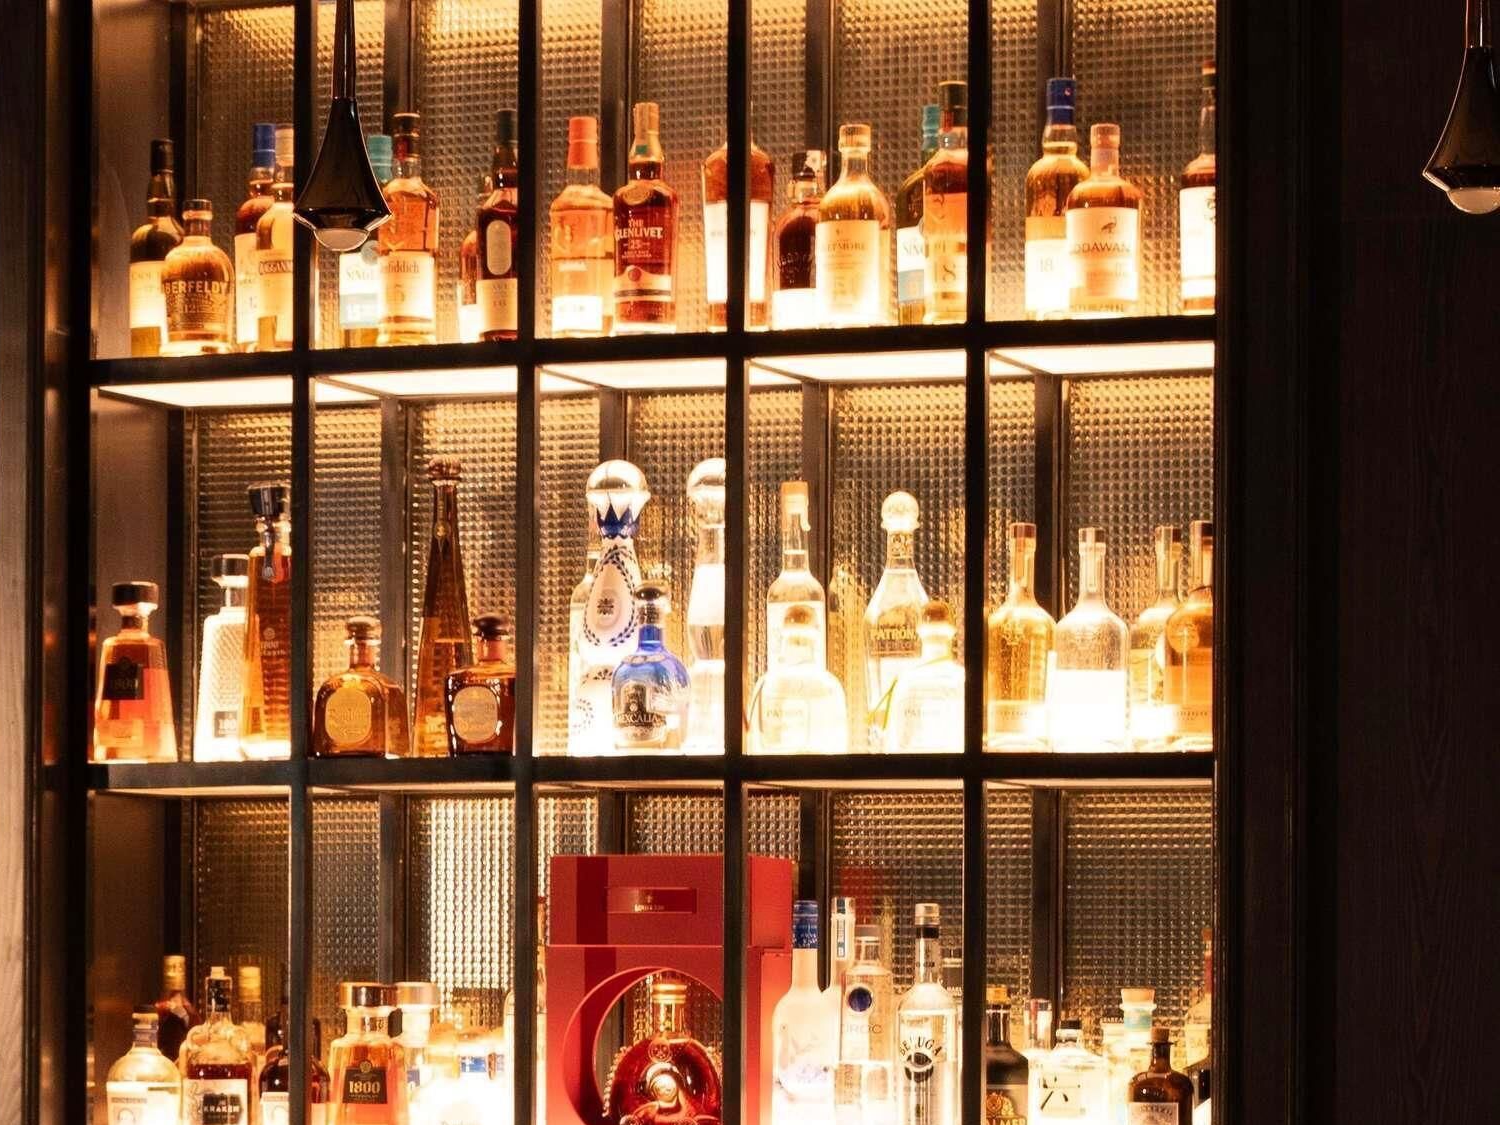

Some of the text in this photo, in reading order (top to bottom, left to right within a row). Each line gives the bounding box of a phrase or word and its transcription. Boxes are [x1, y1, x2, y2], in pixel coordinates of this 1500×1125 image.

[614, 226, 664, 241] GLENLIVET
[163, 280, 230, 295] BERFELDY
[218, 719, 238, 730] 180
[348, 1080, 382, 1094] 1800
[203, 1104, 240, 1113] KRAKEN
